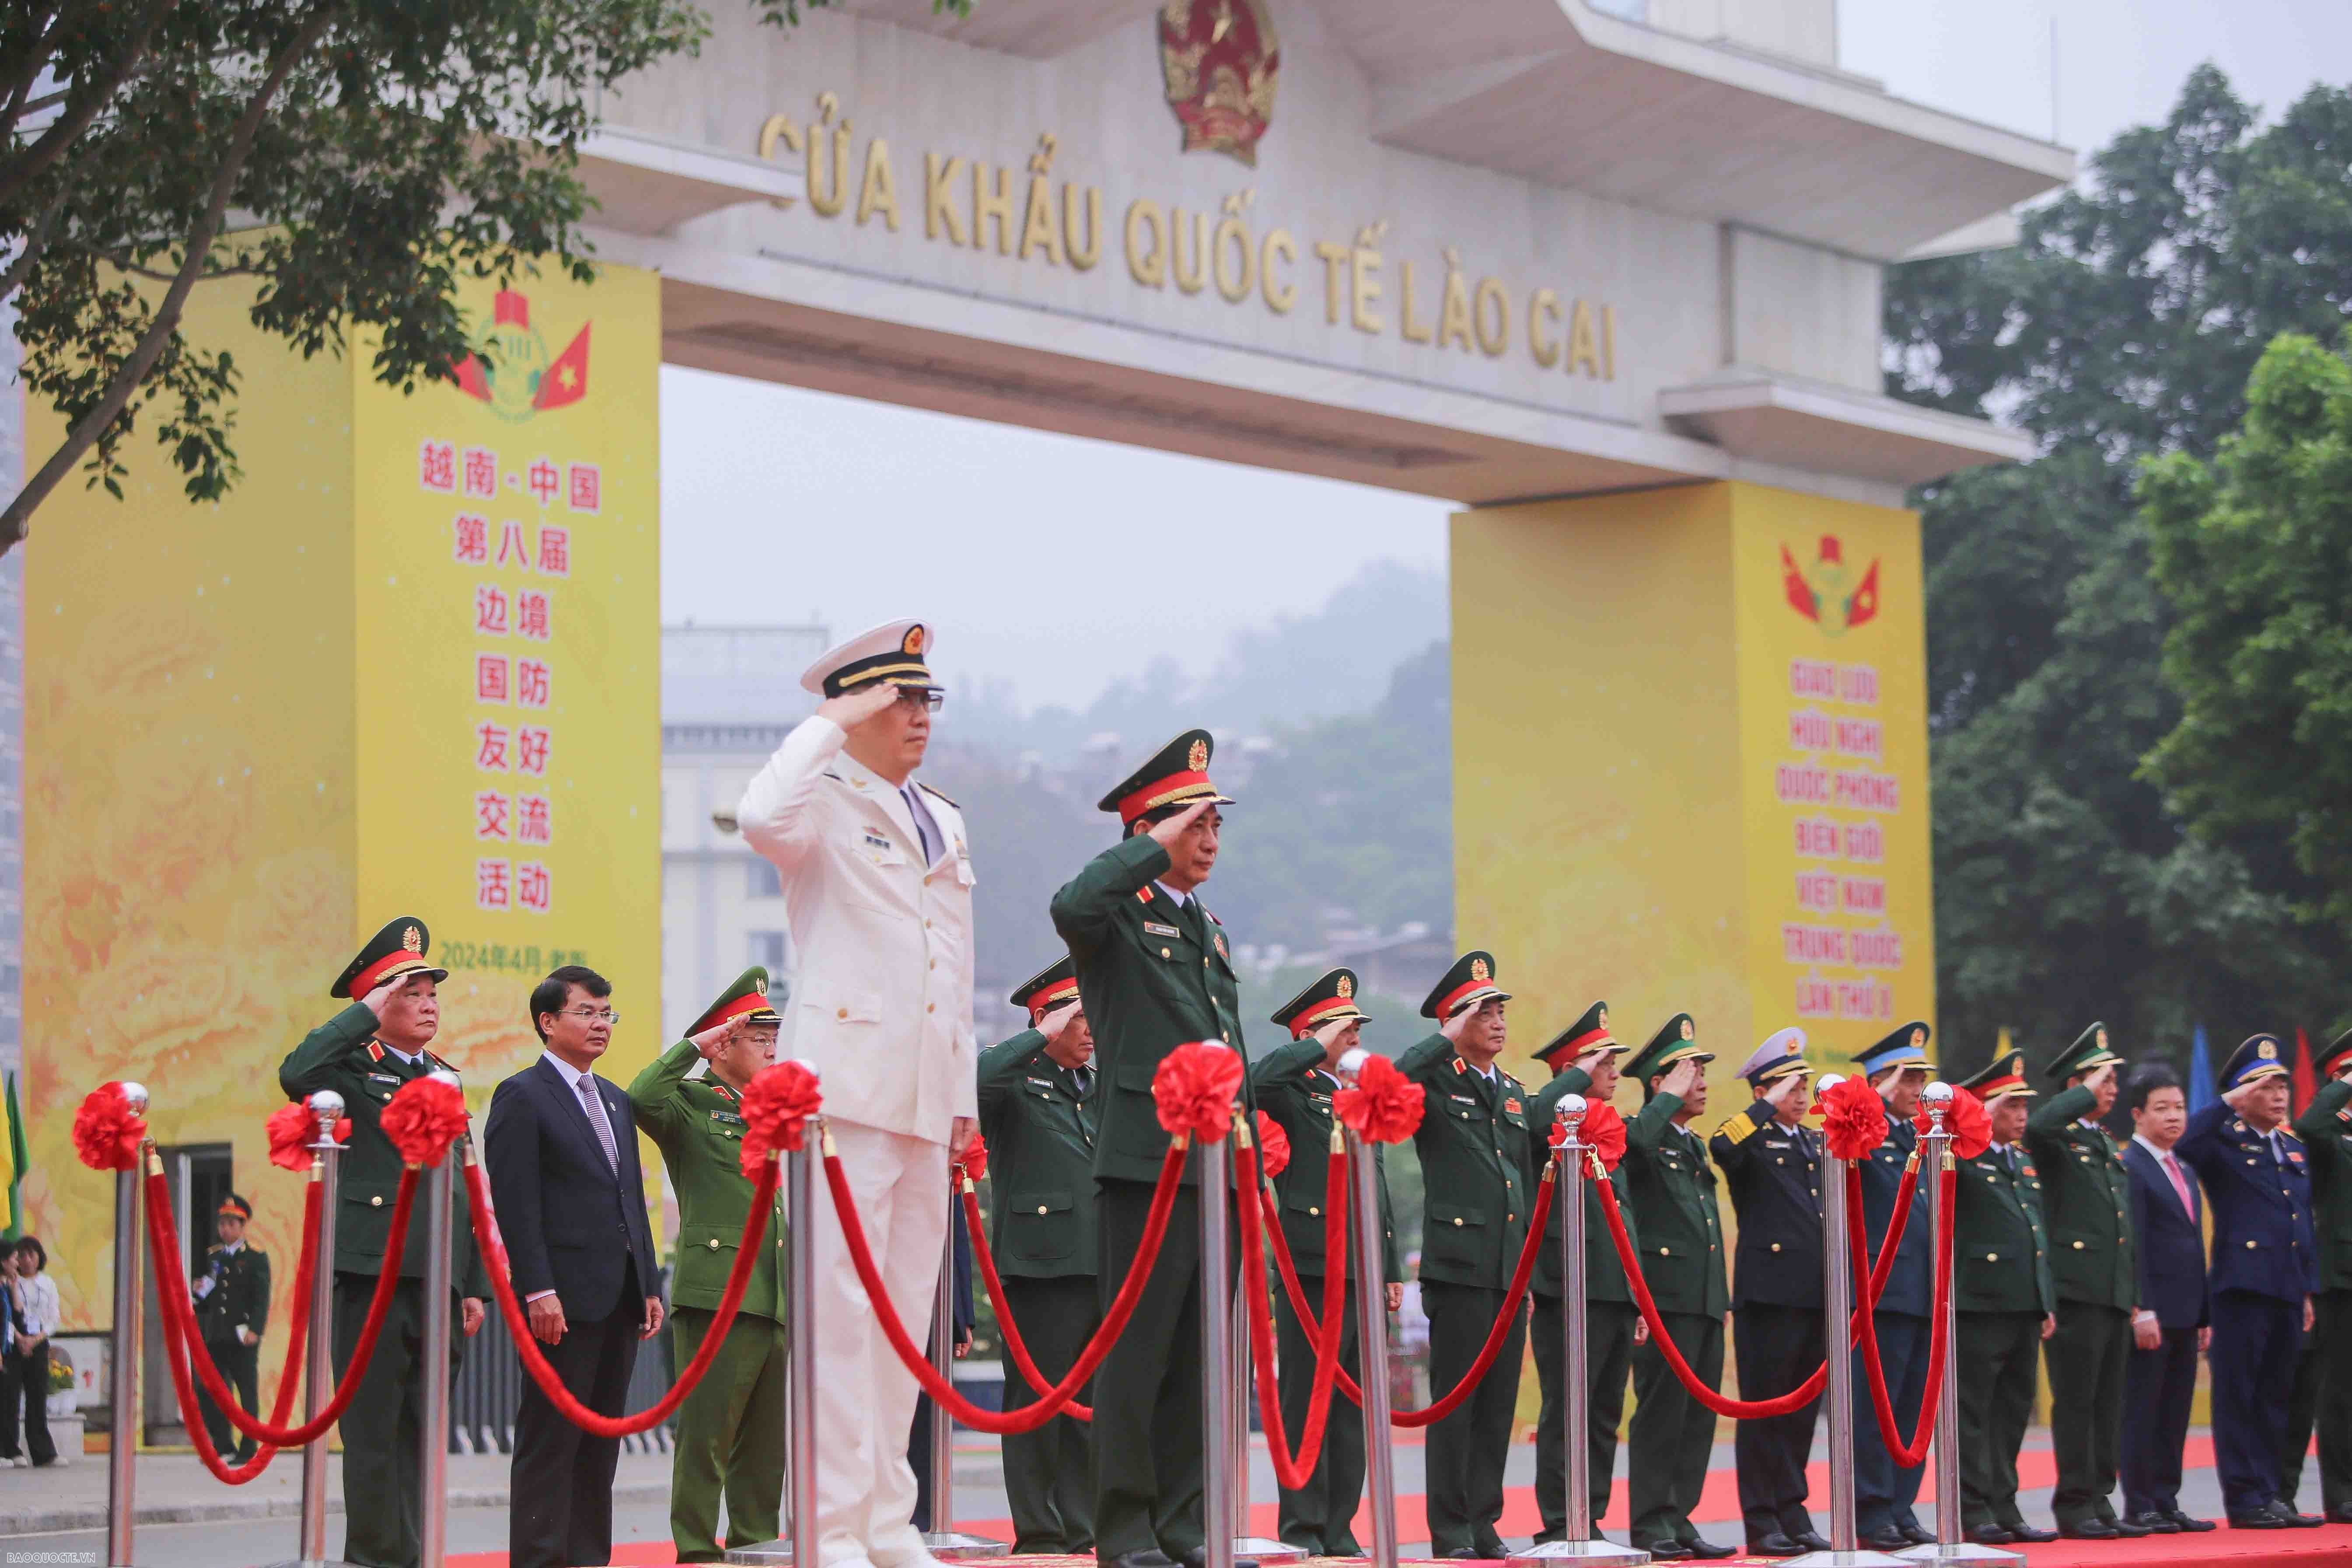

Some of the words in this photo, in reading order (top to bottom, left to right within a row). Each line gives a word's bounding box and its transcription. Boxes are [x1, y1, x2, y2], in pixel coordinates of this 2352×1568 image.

[924, 133, 1102, 273] KHẨU
[1125, 189, 1297, 315] QUỐC
[1314, 219, 1387, 334] TẾ
[1400, 246, 1509, 359] LÀO
[1529, 287, 1615, 382] CAI
[455, 517, 569, 573] 第八届
[476, 587, 549, 639] 边境
[478, 658, 549, 706] 国防
[478, 724, 549, 772] 友好
[478, 793, 550, 841] 交流
[478, 863, 550, 909] 活动
